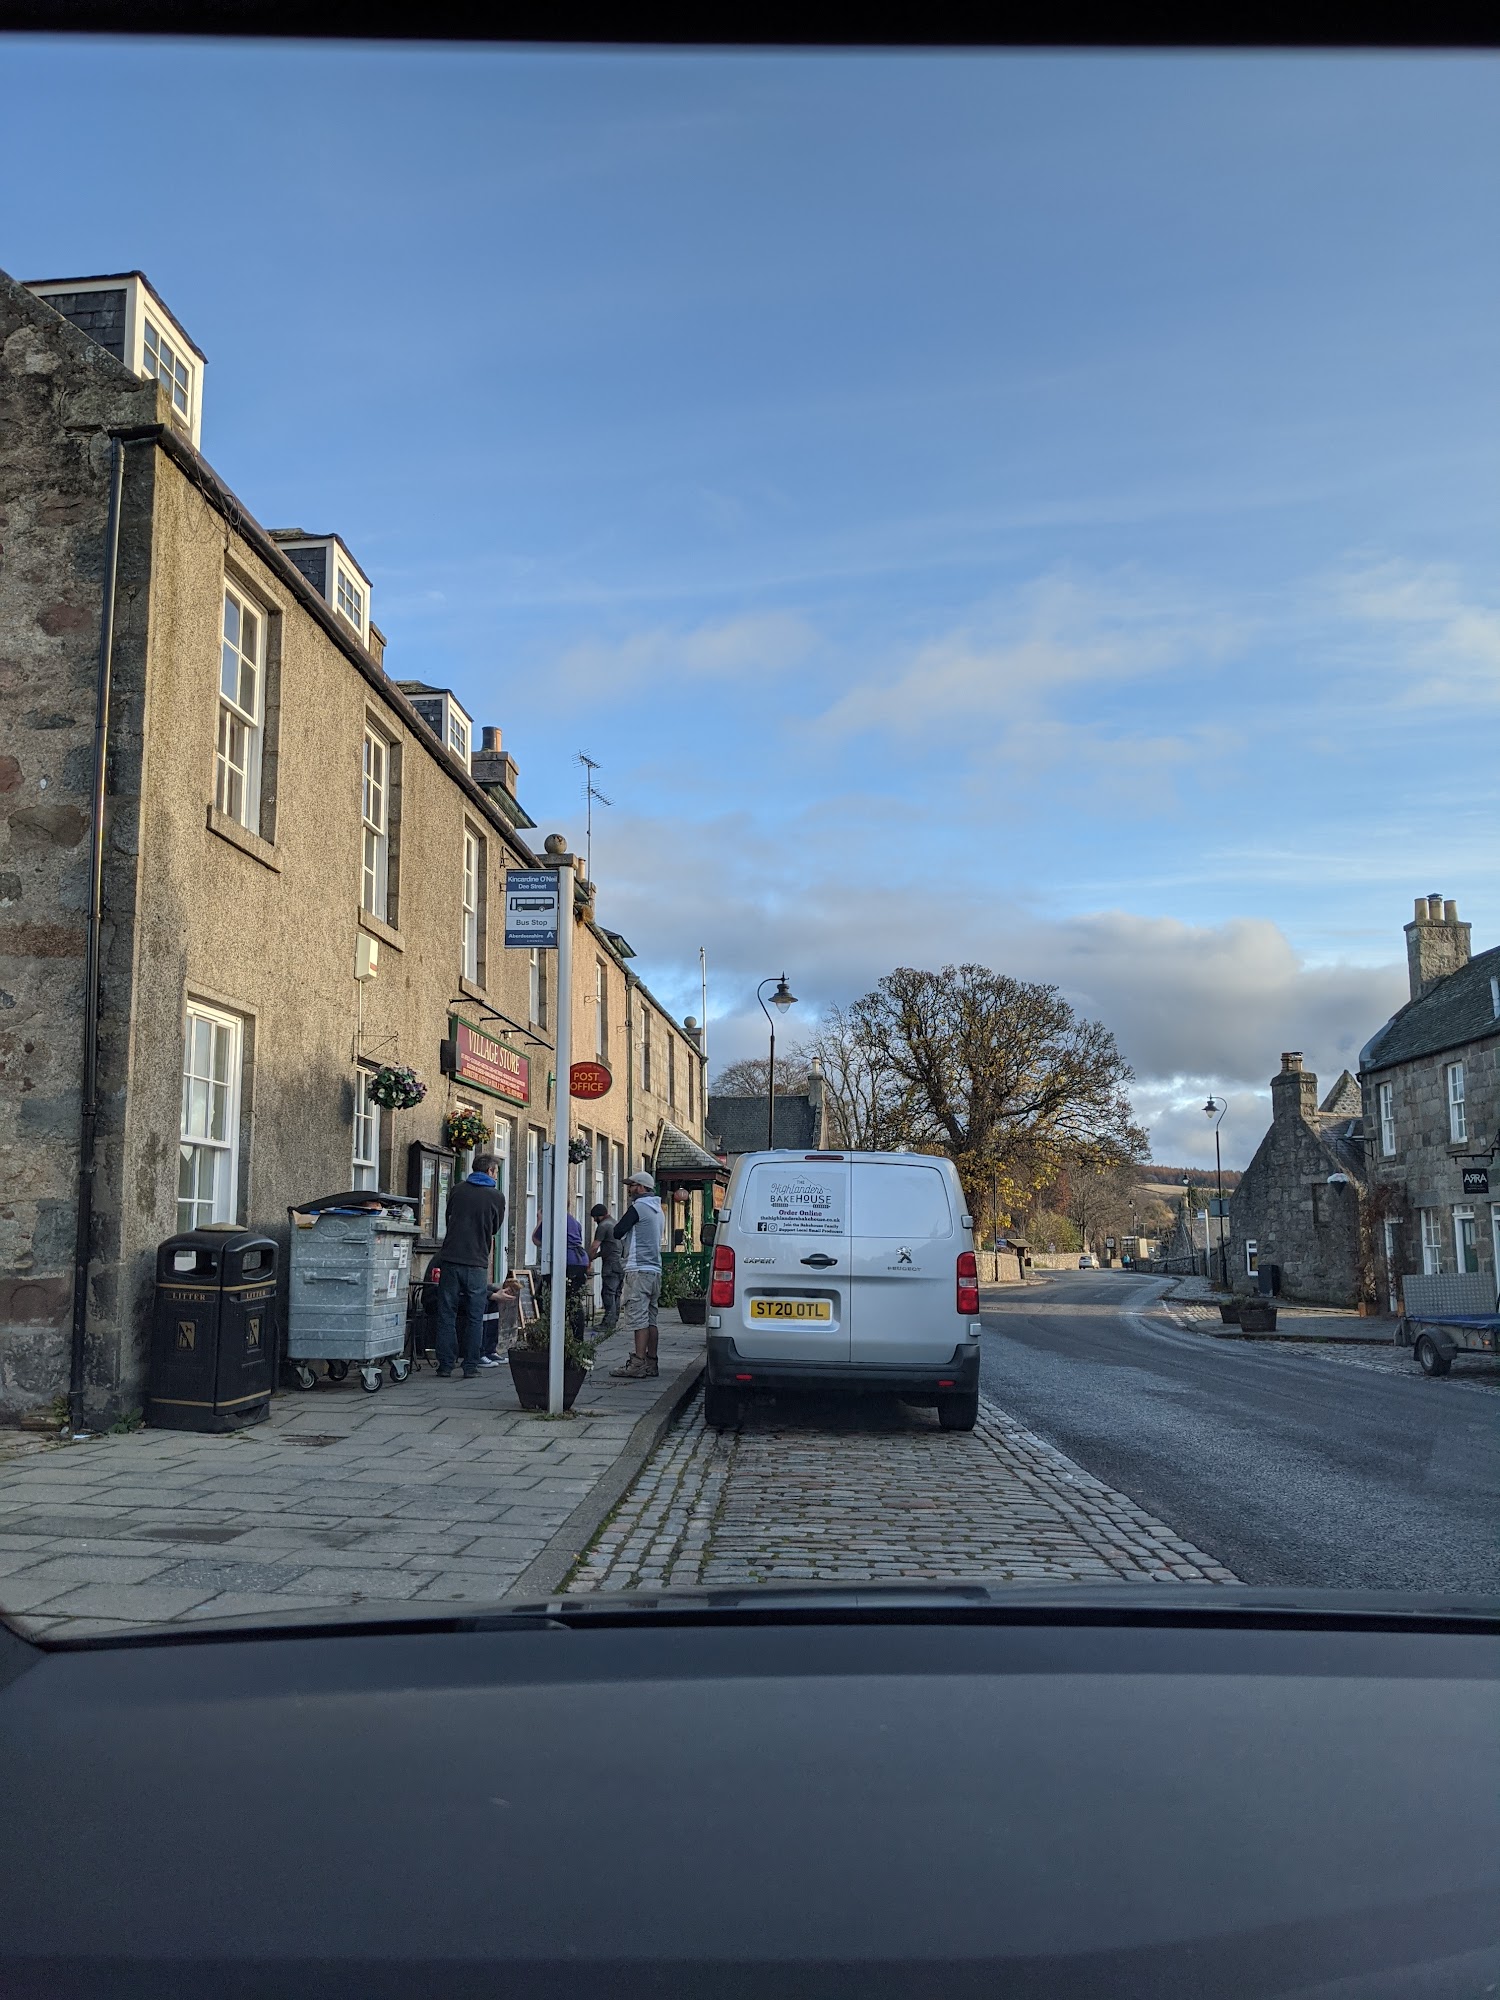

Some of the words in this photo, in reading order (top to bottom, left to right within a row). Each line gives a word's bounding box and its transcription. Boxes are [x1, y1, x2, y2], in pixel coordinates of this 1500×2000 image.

[507, 875, 539, 883] Kincardine
[531, 919, 548, 927] Stop
[468, 1028, 499, 1065] VILLAGE
[500, 1046, 520, 1076] STORE
[573, 1072, 600, 1082] POST
[570, 1082, 604, 1092] OFFICE
[770, 1182, 824, 1195] Highlanders
[770, 1194, 832, 1205] BAKEHOUSE
[799, 1209, 823, 1217] Online
[172, 1292, 206, 1301] LITTER
[246, 1289, 266, 1299] LITTER
[756, 1302, 793, 1316] ST20
[796, 1303, 824, 1317] OTL
